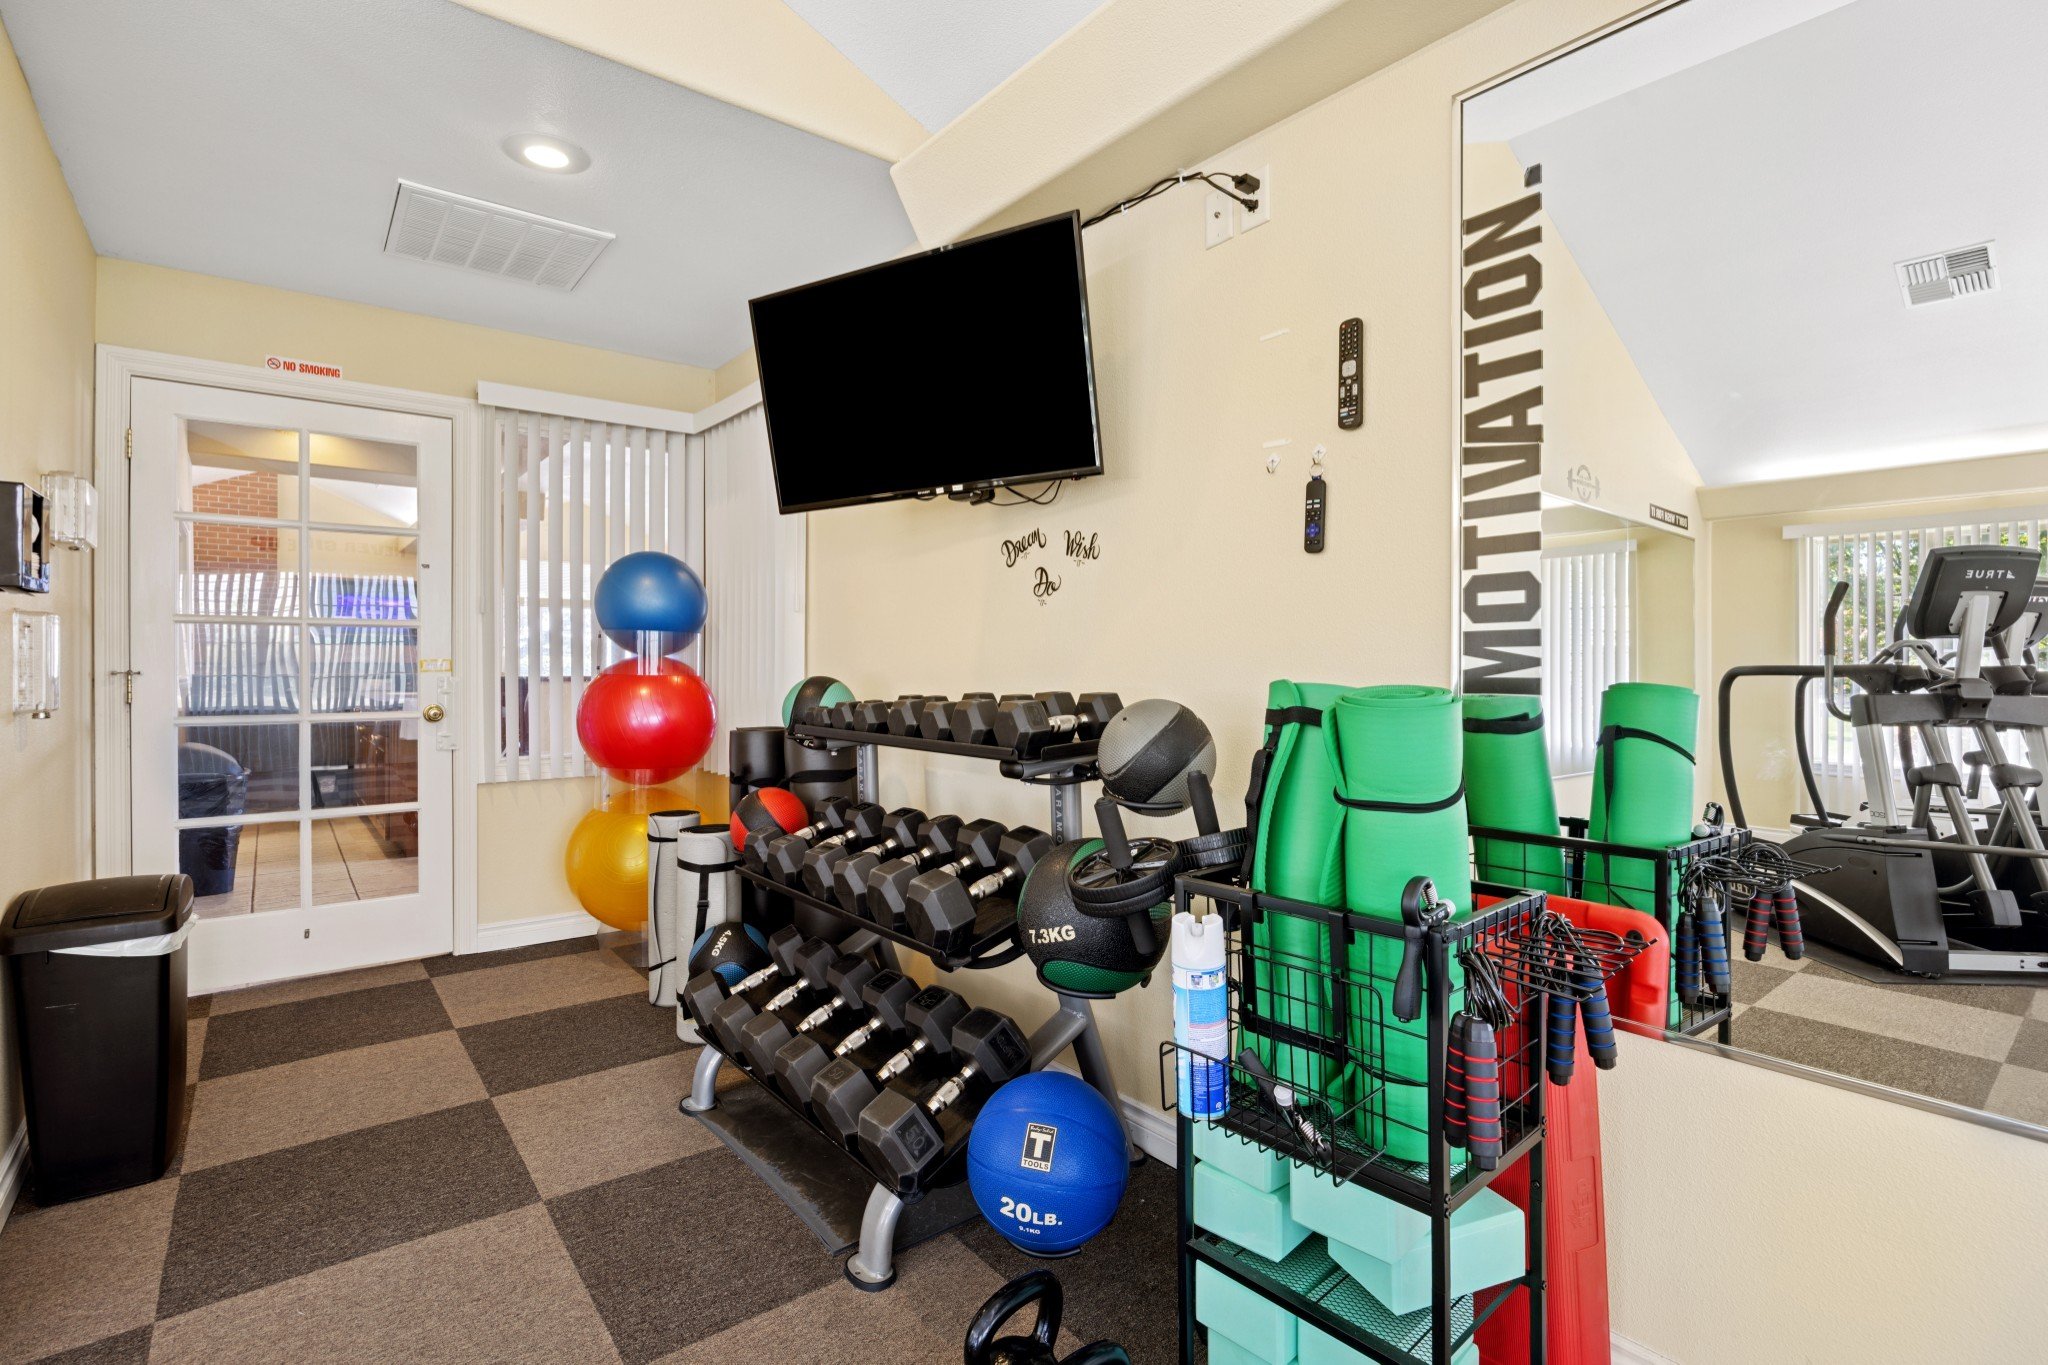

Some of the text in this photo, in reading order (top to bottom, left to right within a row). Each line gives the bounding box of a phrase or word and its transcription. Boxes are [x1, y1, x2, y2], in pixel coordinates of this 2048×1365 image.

[283, 361, 341, 378] NO SMOKING
[1462, 163, 1543, 696] MOTIVATION.
[1001, 527, 1047, 568] Dream
[1064, 530, 1100, 560] Wish
[1033, 567, 1062, 597] Do
[711, 930, 732, 957] 4.5KG
[1029, 925, 1076, 943] 7.3KG
[1030, 1131, 1052, 1159] T
[1023, 1159, 1049, 1170] TOOLS
